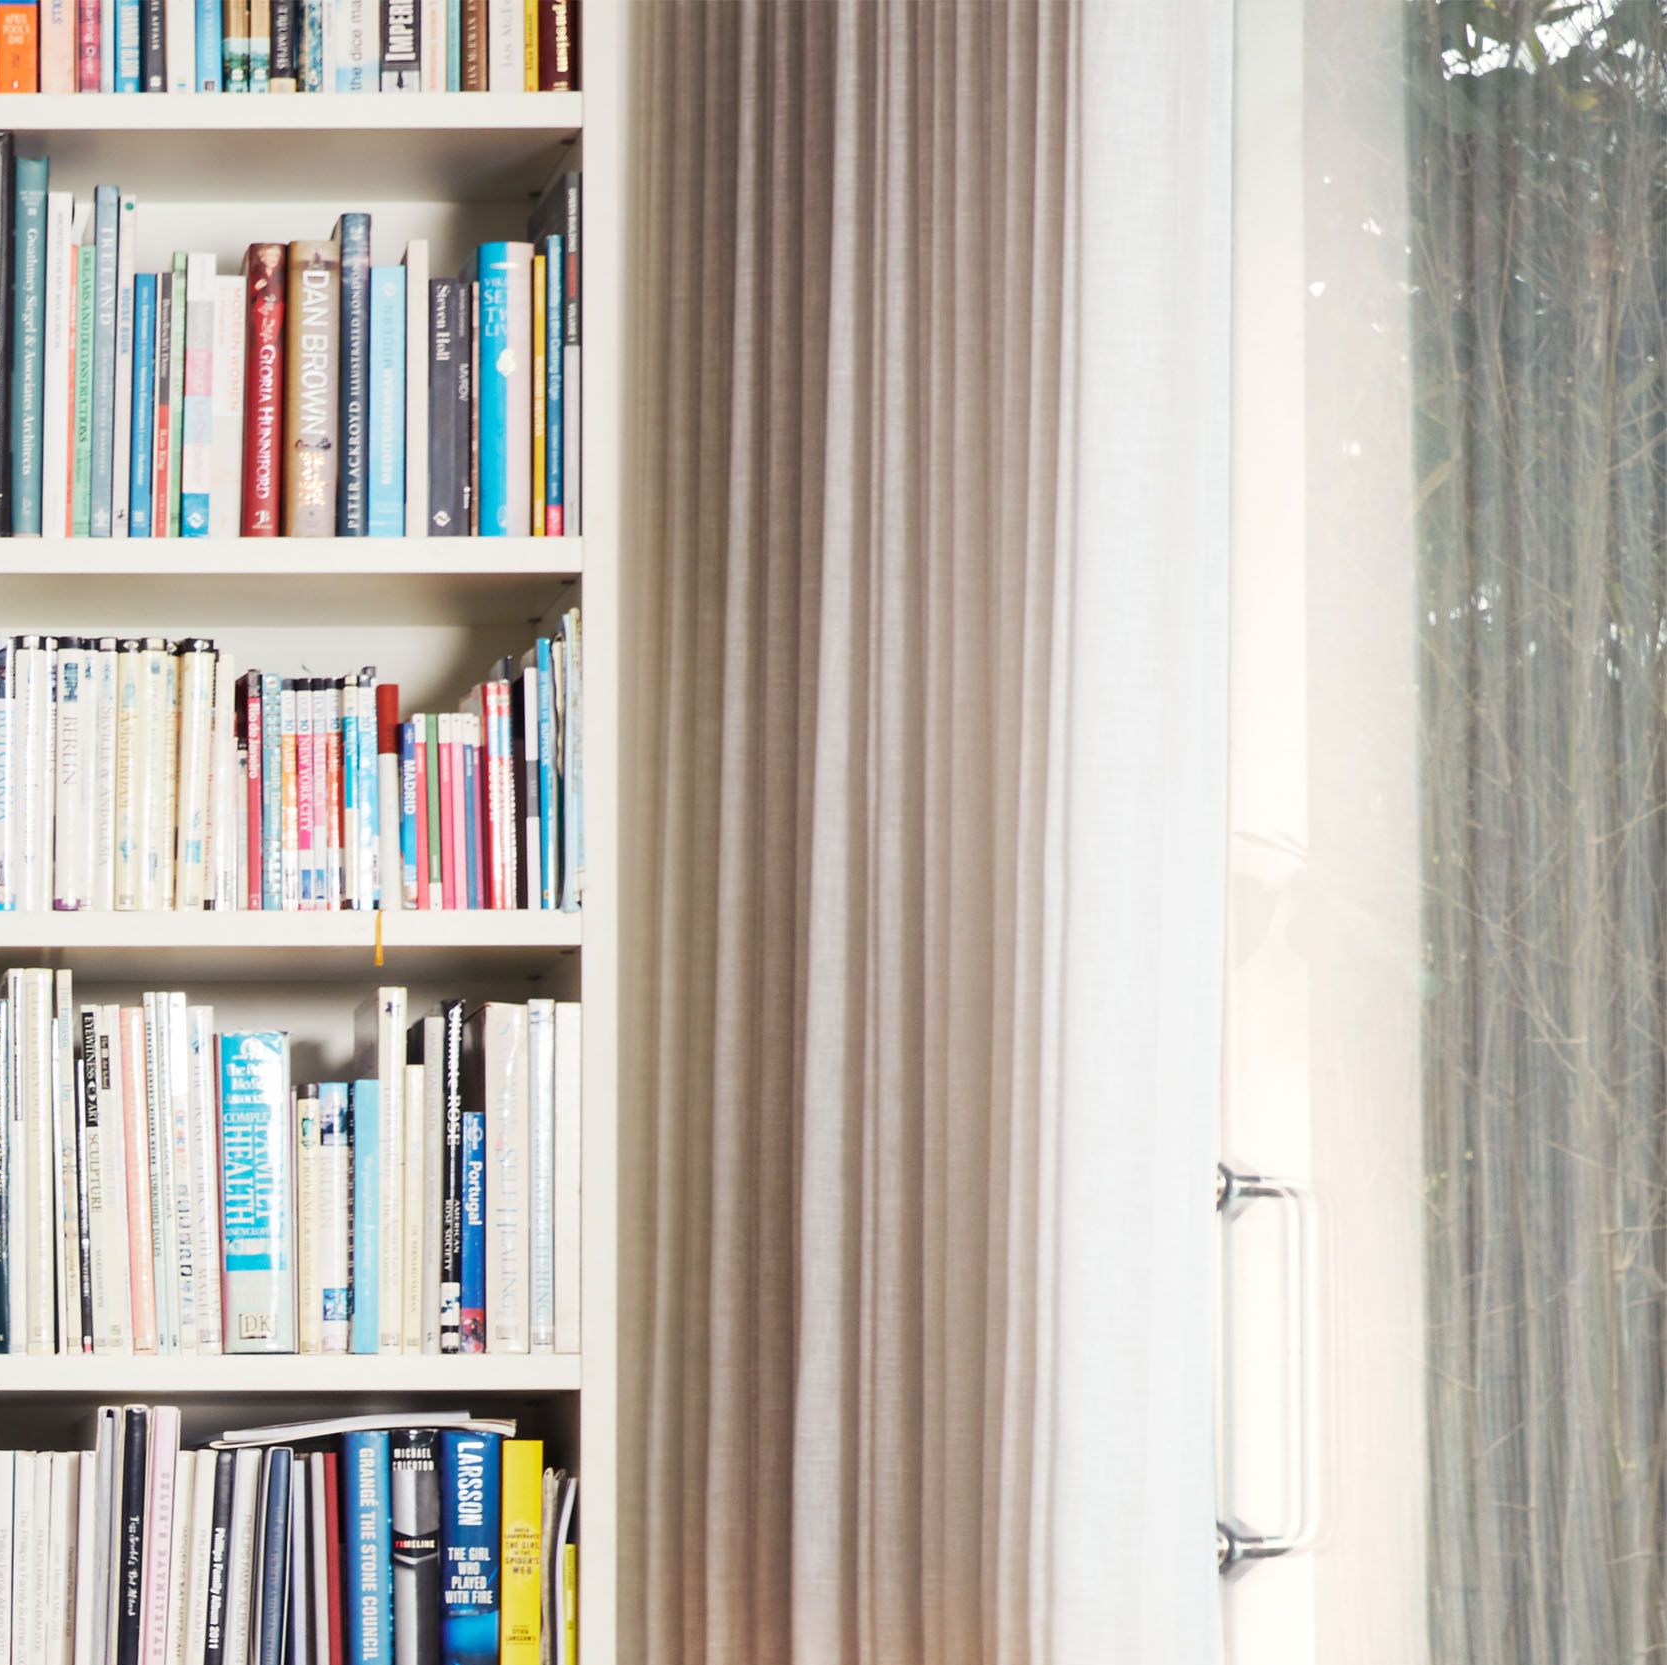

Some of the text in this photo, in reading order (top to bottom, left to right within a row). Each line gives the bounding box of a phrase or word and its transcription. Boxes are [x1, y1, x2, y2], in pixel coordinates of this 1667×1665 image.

[301, 271, 328, 435] DAN BROWN
[465, 1161, 482, 1225] Portugal
[458, 1442, 484, 1526] LARSSON
[360, 1448, 379, 1660] GRANGÉ THE STONE COUNCIL
[448, 1547, 491, 1560] THE GIRL
[457, 1562, 480, 1575] WHO
[445, 1591, 492, 1604] WITH FIRE
[452, 1576, 486, 1589] PLAYED
